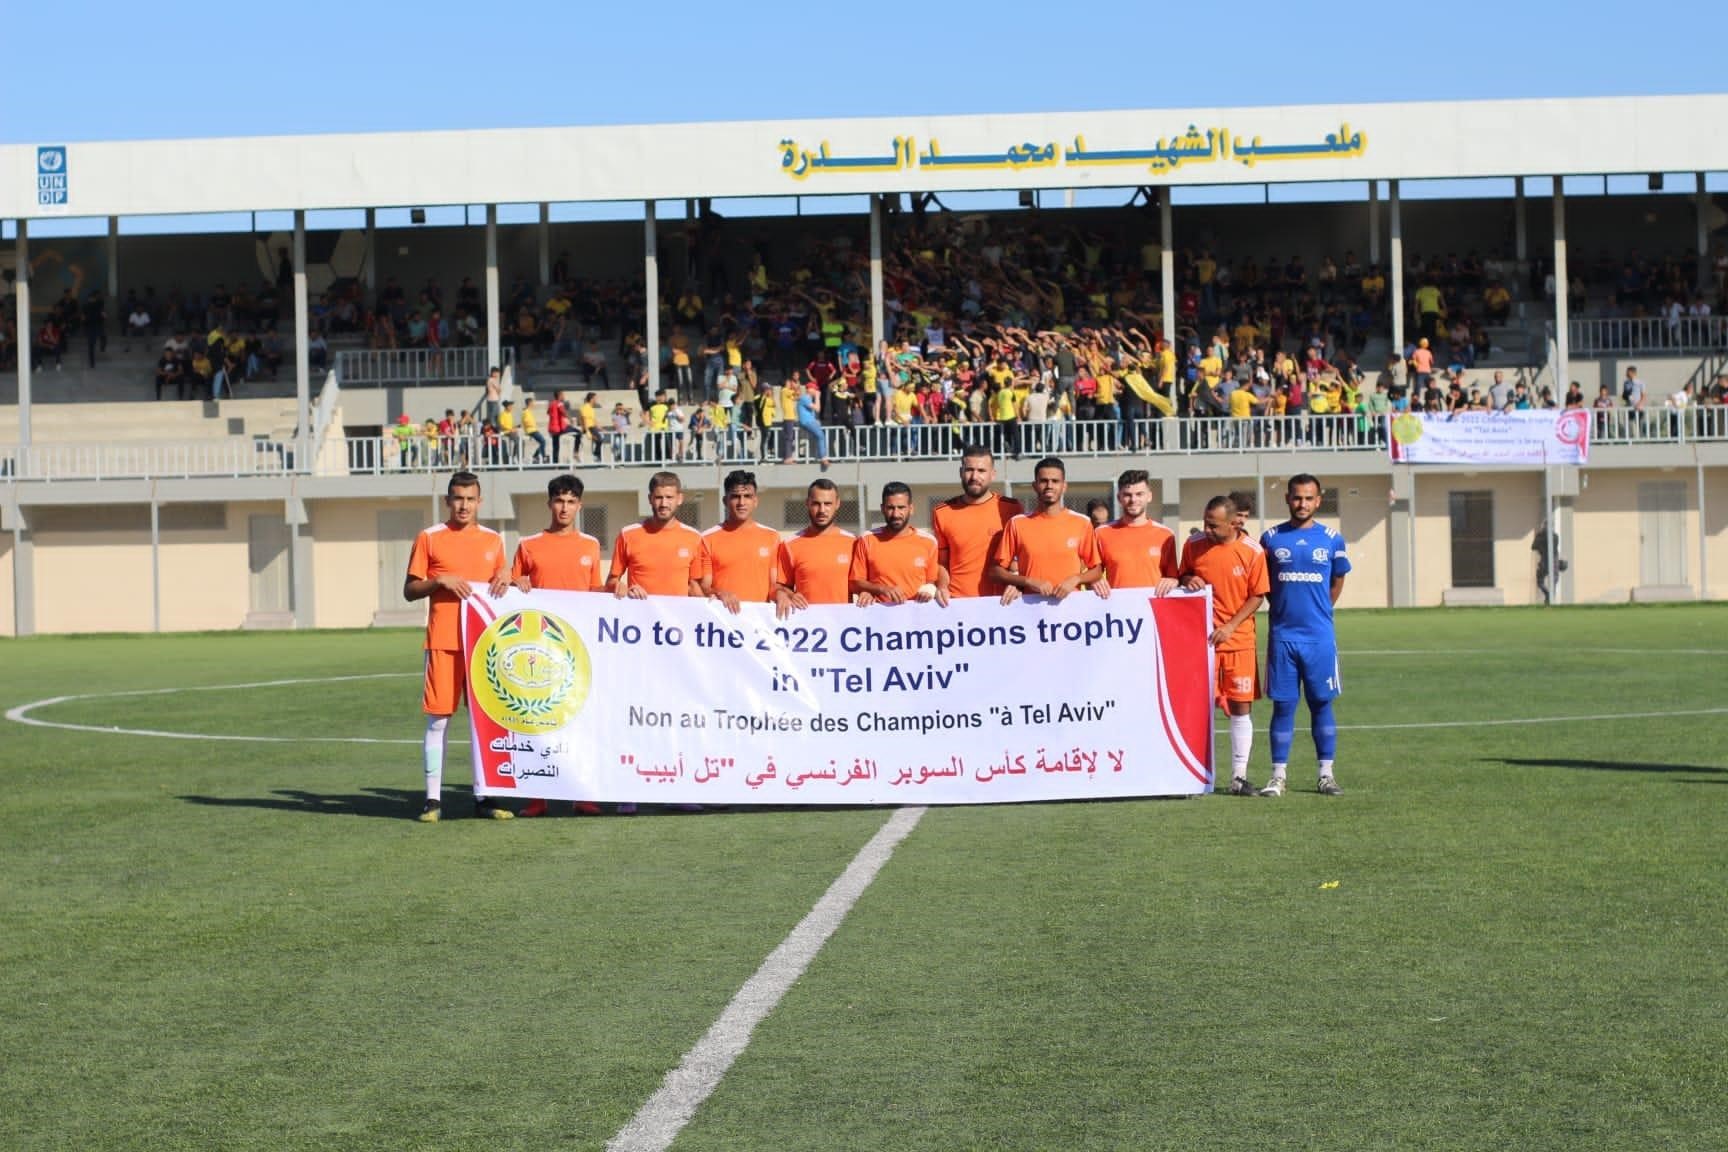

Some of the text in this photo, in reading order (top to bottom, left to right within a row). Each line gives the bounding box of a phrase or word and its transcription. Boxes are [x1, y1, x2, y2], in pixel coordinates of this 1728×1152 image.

[778, 122, 1367, 180] ملعب الشهيد محمد الدرة
[598, 613, 1143, 655] No to the 2022 Champions trophy
[772, 663, 968, 693] in "Tel Aviv"
[630, 700, 1115, 736] Non au Trophée des Champions "à Tel Aviv"
[490, 737, 534, 753] خدمات
[1108, 749, 1124, 772] لا
[499, 762, 560, 781] النصيرات
[745, 755, 776, 787] في
[786, 757, 877, 789] الفرنسي
[889, 756, 963, 786] السوبر
[976, 749, 1026, 782] كأس
[1035, 747, 1097, 779] لإقامة
